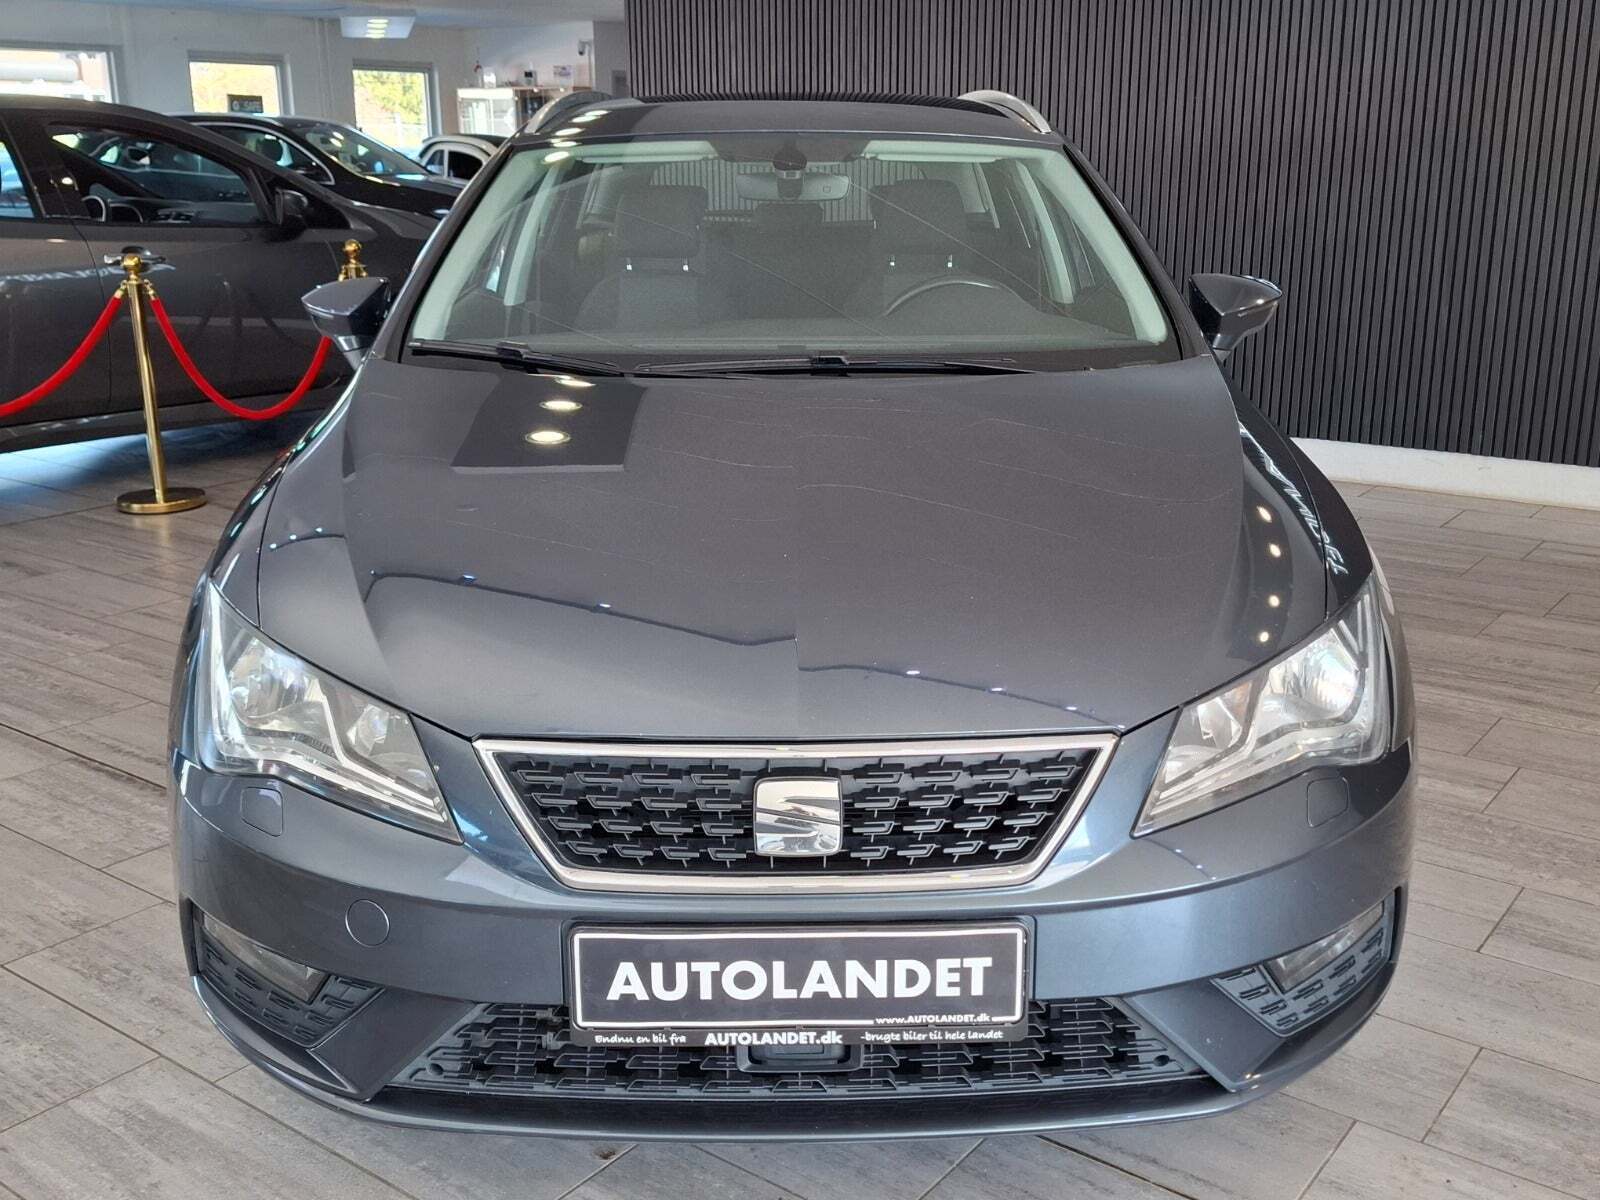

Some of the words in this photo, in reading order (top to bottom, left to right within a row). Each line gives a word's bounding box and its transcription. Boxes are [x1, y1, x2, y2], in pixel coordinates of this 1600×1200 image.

[606, 956, 993, 1002] AUTOLANDET
[874, 1012, 992, 1025] www.AUTOLANDET.dk
[594, 1033, 635, 1044] Endnu
[636, 1036, 651, 1044] en
[652, 1032, 668, 1044] bil
[669, 1033, 687, 1047] fra
[704, 1030, 844, 1047] AUTOLANDET.dk
[902, 1029, 928, 1041] biler
[929, 1028, 943, 1041] til
[944, 1029, 967, 1041] hele
[968, 1028, 1004, 1040] landet
